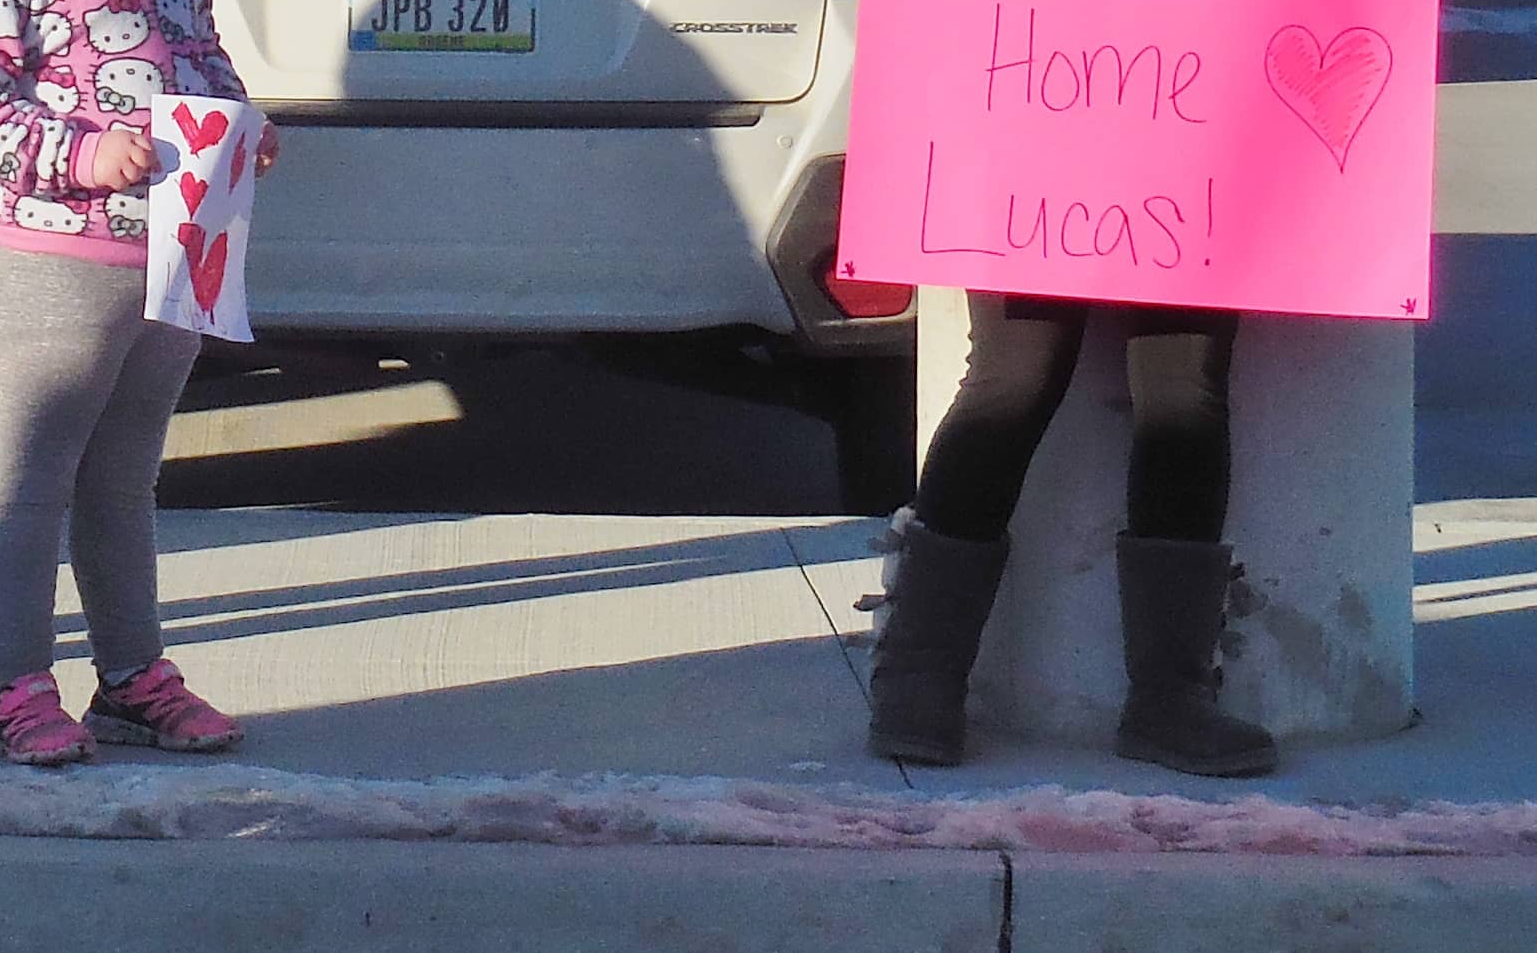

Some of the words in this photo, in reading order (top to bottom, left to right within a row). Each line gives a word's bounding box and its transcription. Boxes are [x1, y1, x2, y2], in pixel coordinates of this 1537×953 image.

[669, 22, 798, 34] CROSSTREK
[985, 3, 1208, 123] Home
[920, 140, 1214, 268] Lucas!
